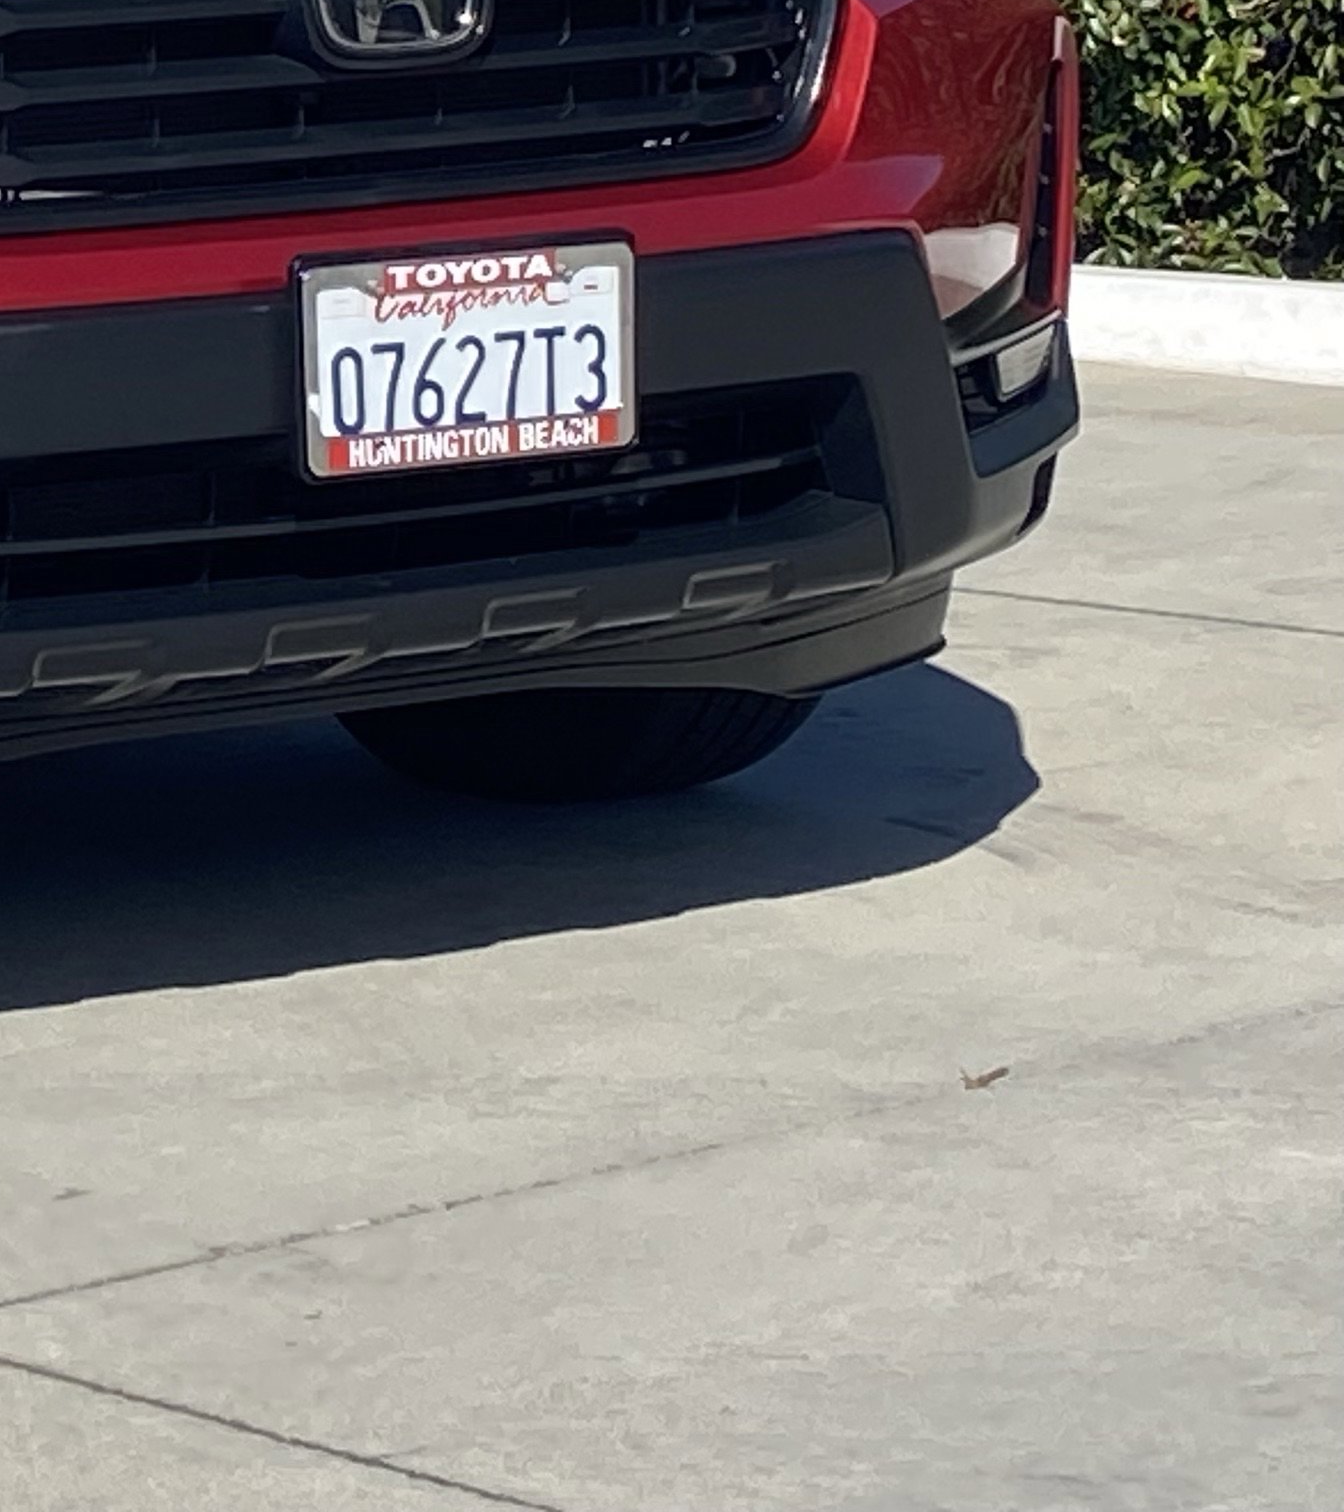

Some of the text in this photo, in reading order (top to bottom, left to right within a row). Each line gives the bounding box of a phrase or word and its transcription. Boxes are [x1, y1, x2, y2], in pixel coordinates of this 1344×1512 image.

[387, 254, 552, 289] TOYOTA
[374, 283, 549, 330] California
[330, 324, 608, 435] 07627T3
[348, 417, 600, 468] HUNTINGTON BEACH
